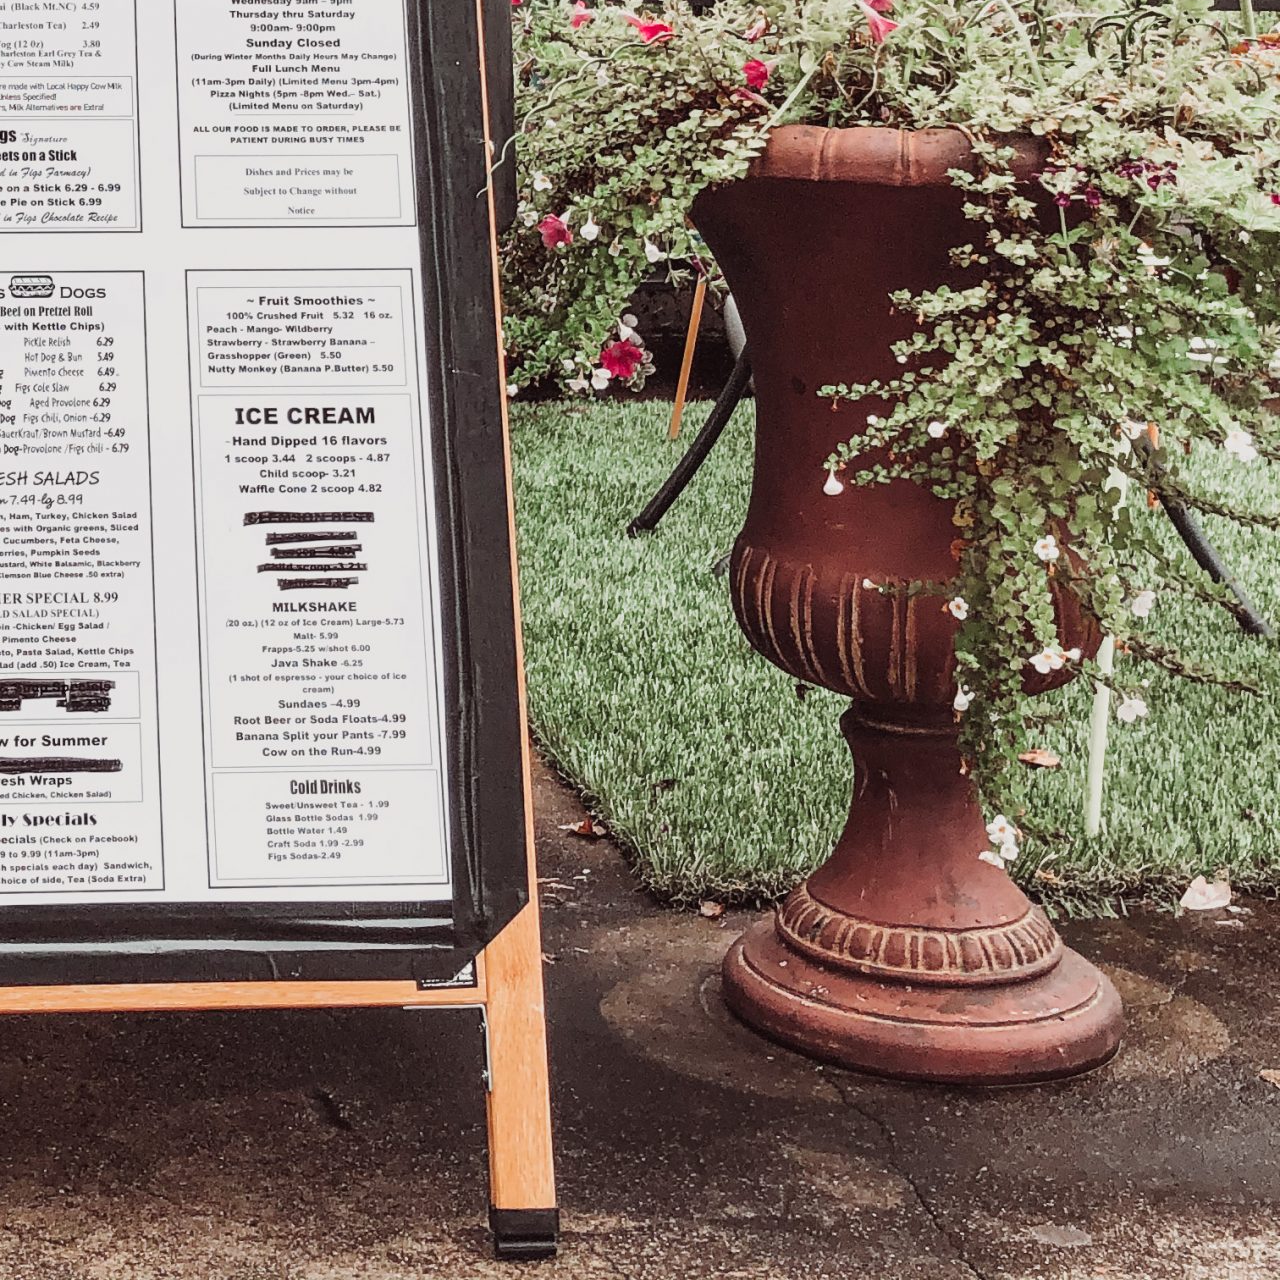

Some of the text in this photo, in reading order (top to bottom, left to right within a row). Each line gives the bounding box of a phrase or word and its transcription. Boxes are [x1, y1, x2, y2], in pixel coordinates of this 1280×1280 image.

[228, 9, 356, 21] Thursday thru Saturday
[245, 38, 341, 50] Sunday Closed
[251, 64, 341, 73] Full Lunch Menu
[21, 151, 37, 162] on
[38, 151, 46, 162] a
[47, 149, 78, 162] Stick
[10, 197, 28, 207] Pie
[29, 199, 44, 207] on
[47, 197, 76, 207] Stick
[78, 197, 103, 207] 6.99
[258, 295, 364, 306] Fruit Smoothies
[234, 406, 376, 425] ICE CREAM
[270, 435, 318, 449] Dipped
[321, 435, 338, 446] 16
[341, 435, 388, 446] flavors
[32, 470, 100, 487] SALADS
[25, 591, 90, 605] SPECIAL
[93, 591, 119, 604] 8.99
[272, 601, 358, 613] MILKSHAKE
[270, 657, 338, 668] Java Shake
[13, 735, 37, 748] for
[41, 734, 108, 747] Summer
[29, 774, 73, 789] Wraps
[289, 778, 362, 795] Cold Drinks
[22, 811, 98, 827] Specials
